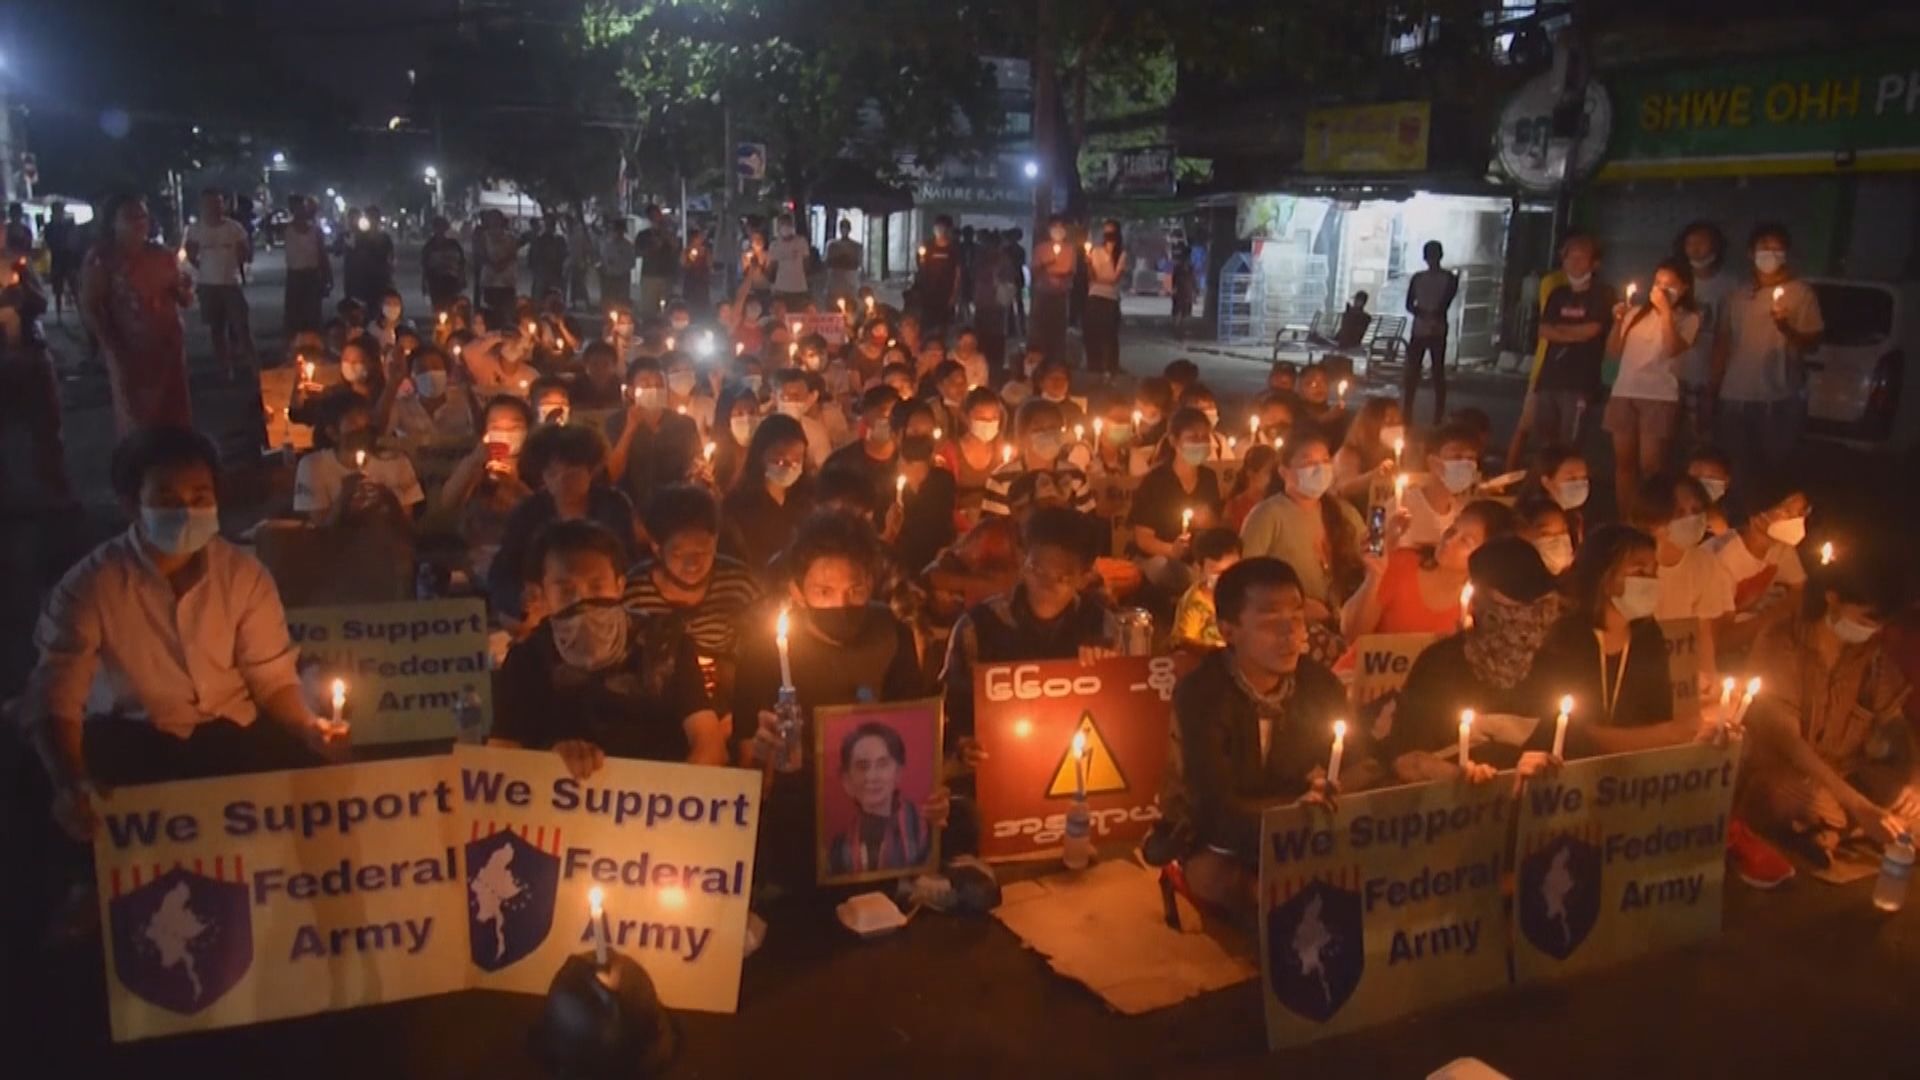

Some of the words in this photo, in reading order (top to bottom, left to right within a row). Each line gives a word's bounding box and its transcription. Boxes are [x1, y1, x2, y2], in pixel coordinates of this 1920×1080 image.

[1641, 86, 1752, 133] SHWE
[1765, 75, 1861, 123] OHH
[343, 614, 481, 643] Support
[358, 651, 485, 677] Federal
[1364, 651, 1408, 675] We
[461, 767, 532, 806] We
[552, 777, 749, 827] Support
[1531, 783, 1583, 817] We
[1594, 760, 1731, 806] Support
[105, 811, 199, 848] We
[223, 781, 454, 838] Support
[1271, 827, 1334, 863] We
[1349, 793, 1506, 847] Support
[1605, 813, 1725, 864] Federal
[253, 847, 457, 905] Federal
[563, 847, 745, 897] Federal
[1365, 852, 1500, 911] Federal
[1619, 874, 1704, 913] Army
[290, 917, 433, 963] Army
[580, 912, 712, 962] Army
[1388, 920, 1480, 965] Army
